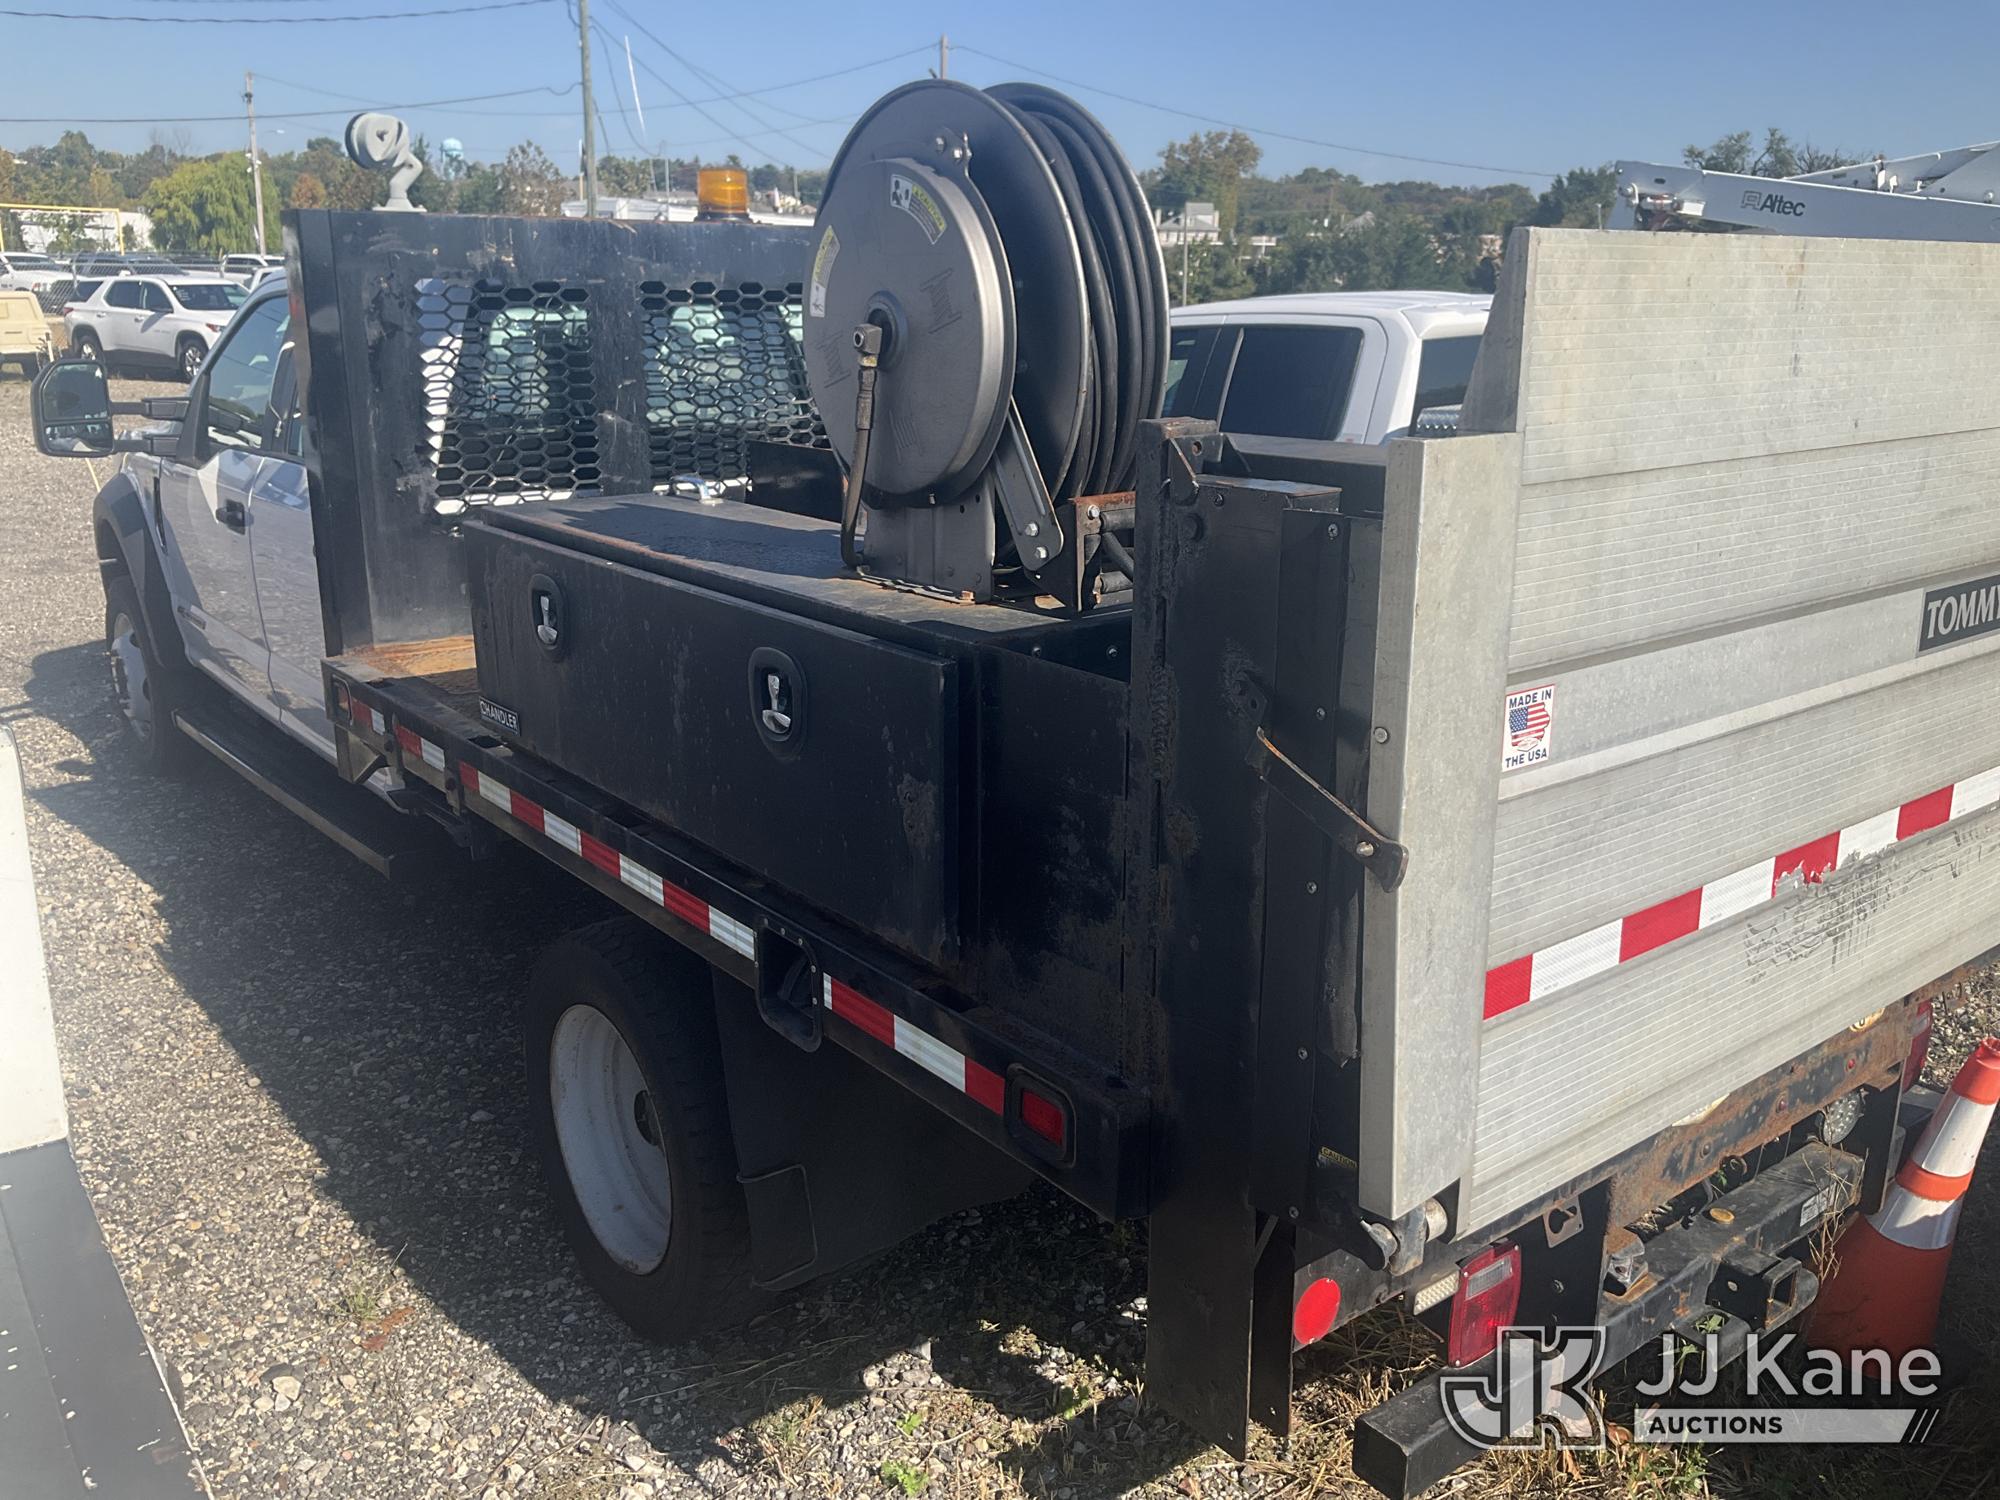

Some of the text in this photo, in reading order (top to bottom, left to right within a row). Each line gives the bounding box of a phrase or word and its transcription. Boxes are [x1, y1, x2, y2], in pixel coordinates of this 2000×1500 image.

[1760, 193, 1806, 217] Altec
[1927, 584, 2000, 639] TOMM
[1509, 689, 1552, 709] MADE IN
[480, 700, 518, 731] CHANDLER
[1505, 748, 1548, 768] THE USA
